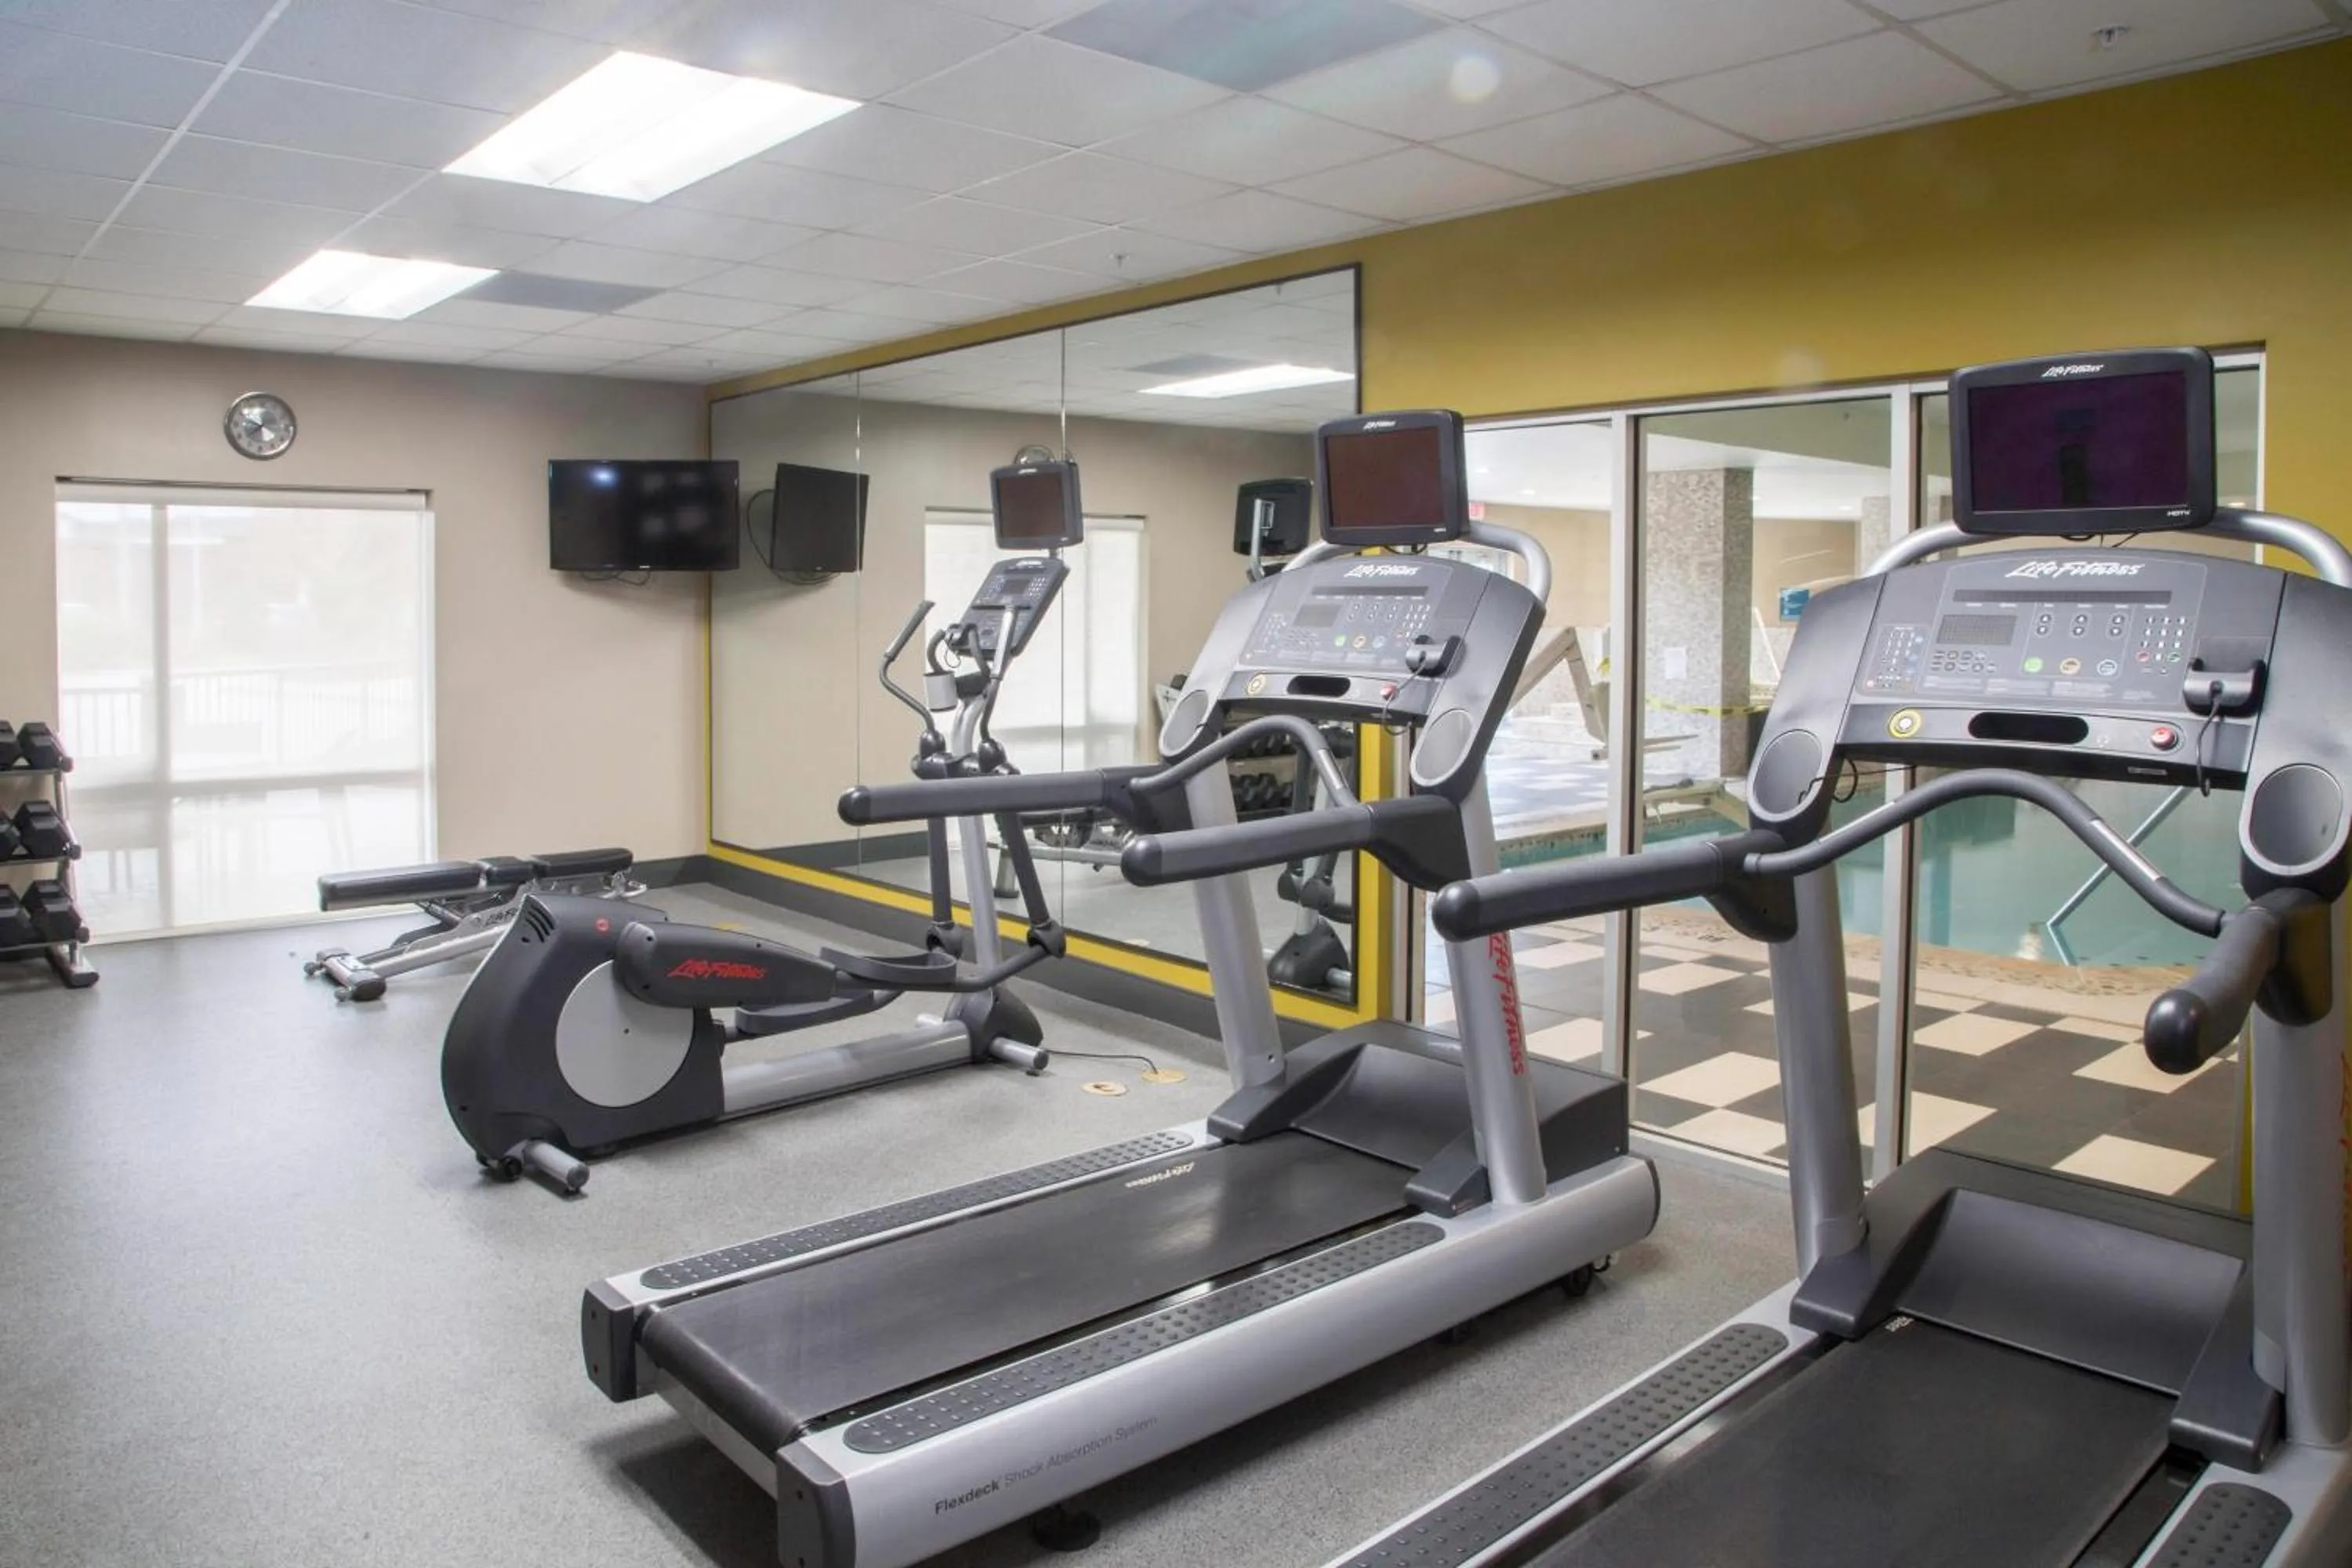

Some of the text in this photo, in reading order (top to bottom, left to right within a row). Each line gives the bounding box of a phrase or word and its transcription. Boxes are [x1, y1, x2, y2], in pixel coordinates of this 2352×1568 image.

[2004, 561, 2146, 579] Life Fitness
[666, 957, 709, 979] Life
[934, 1479, 1000, 1515] Flexdeck
[1004, 1461, 1044, 1487] Shock
[1046, 1434, 1113, 1471] Absorption
